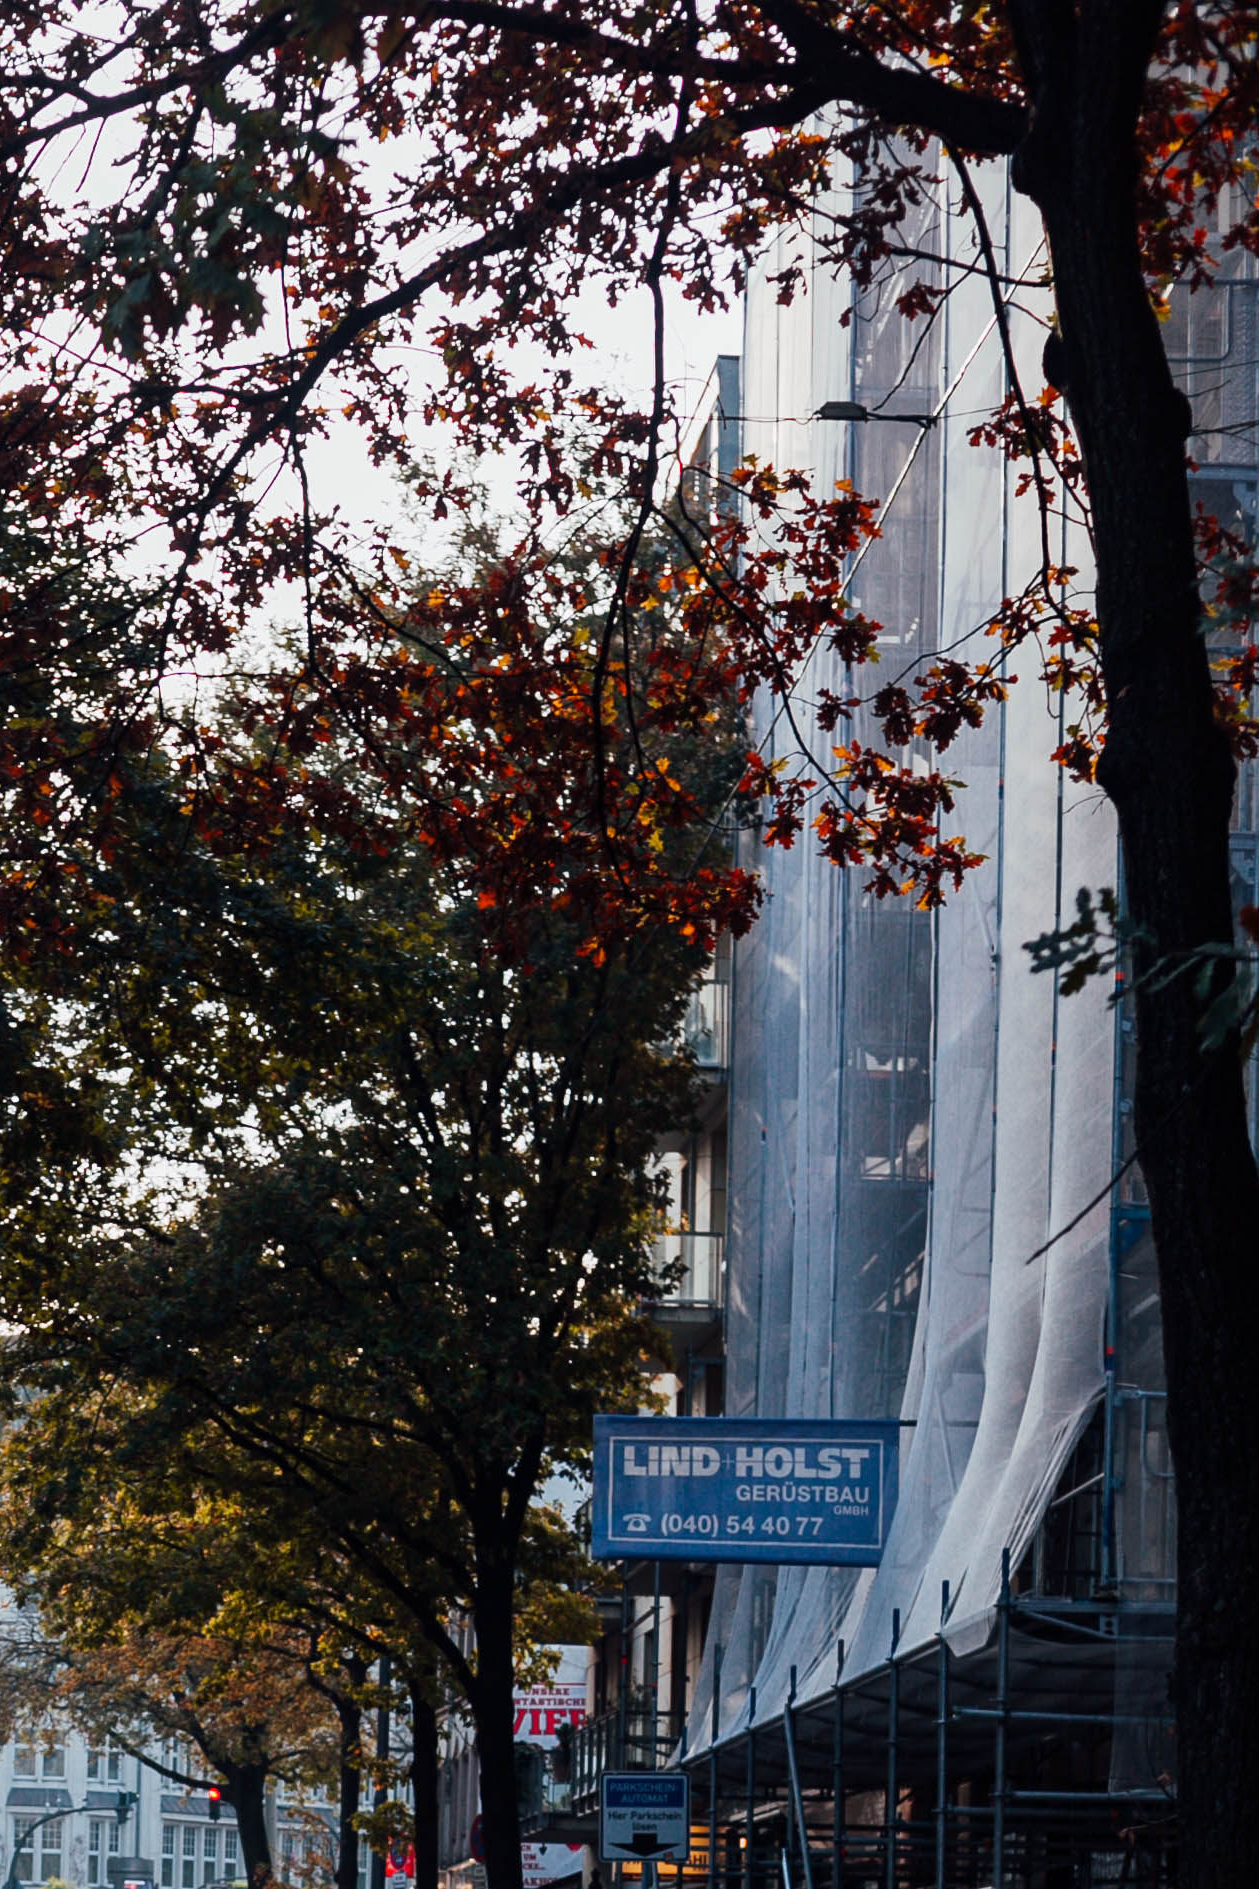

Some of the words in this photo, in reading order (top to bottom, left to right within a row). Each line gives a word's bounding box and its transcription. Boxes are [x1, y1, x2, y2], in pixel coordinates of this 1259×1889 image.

[623, 1445, 721, 1477] LIND
[735, 1447, 870, 1479] HOLST
[736, 1481, 870, 1504] GERÜSTBAU
[833, 1505, 869, 1517] GMBH
[660, 1512, 719, 1538] (040)
[726, 1515, 755, 1535] 54
[761, 1516, 790, 1536] 40
[795, 1517, 824, 1536] 77
[620, 1793, 669, 1804] AUTOMAT
[608, 1810, 628, 1820] Hier
[630, 1810, 682, 1820] Parkschein
